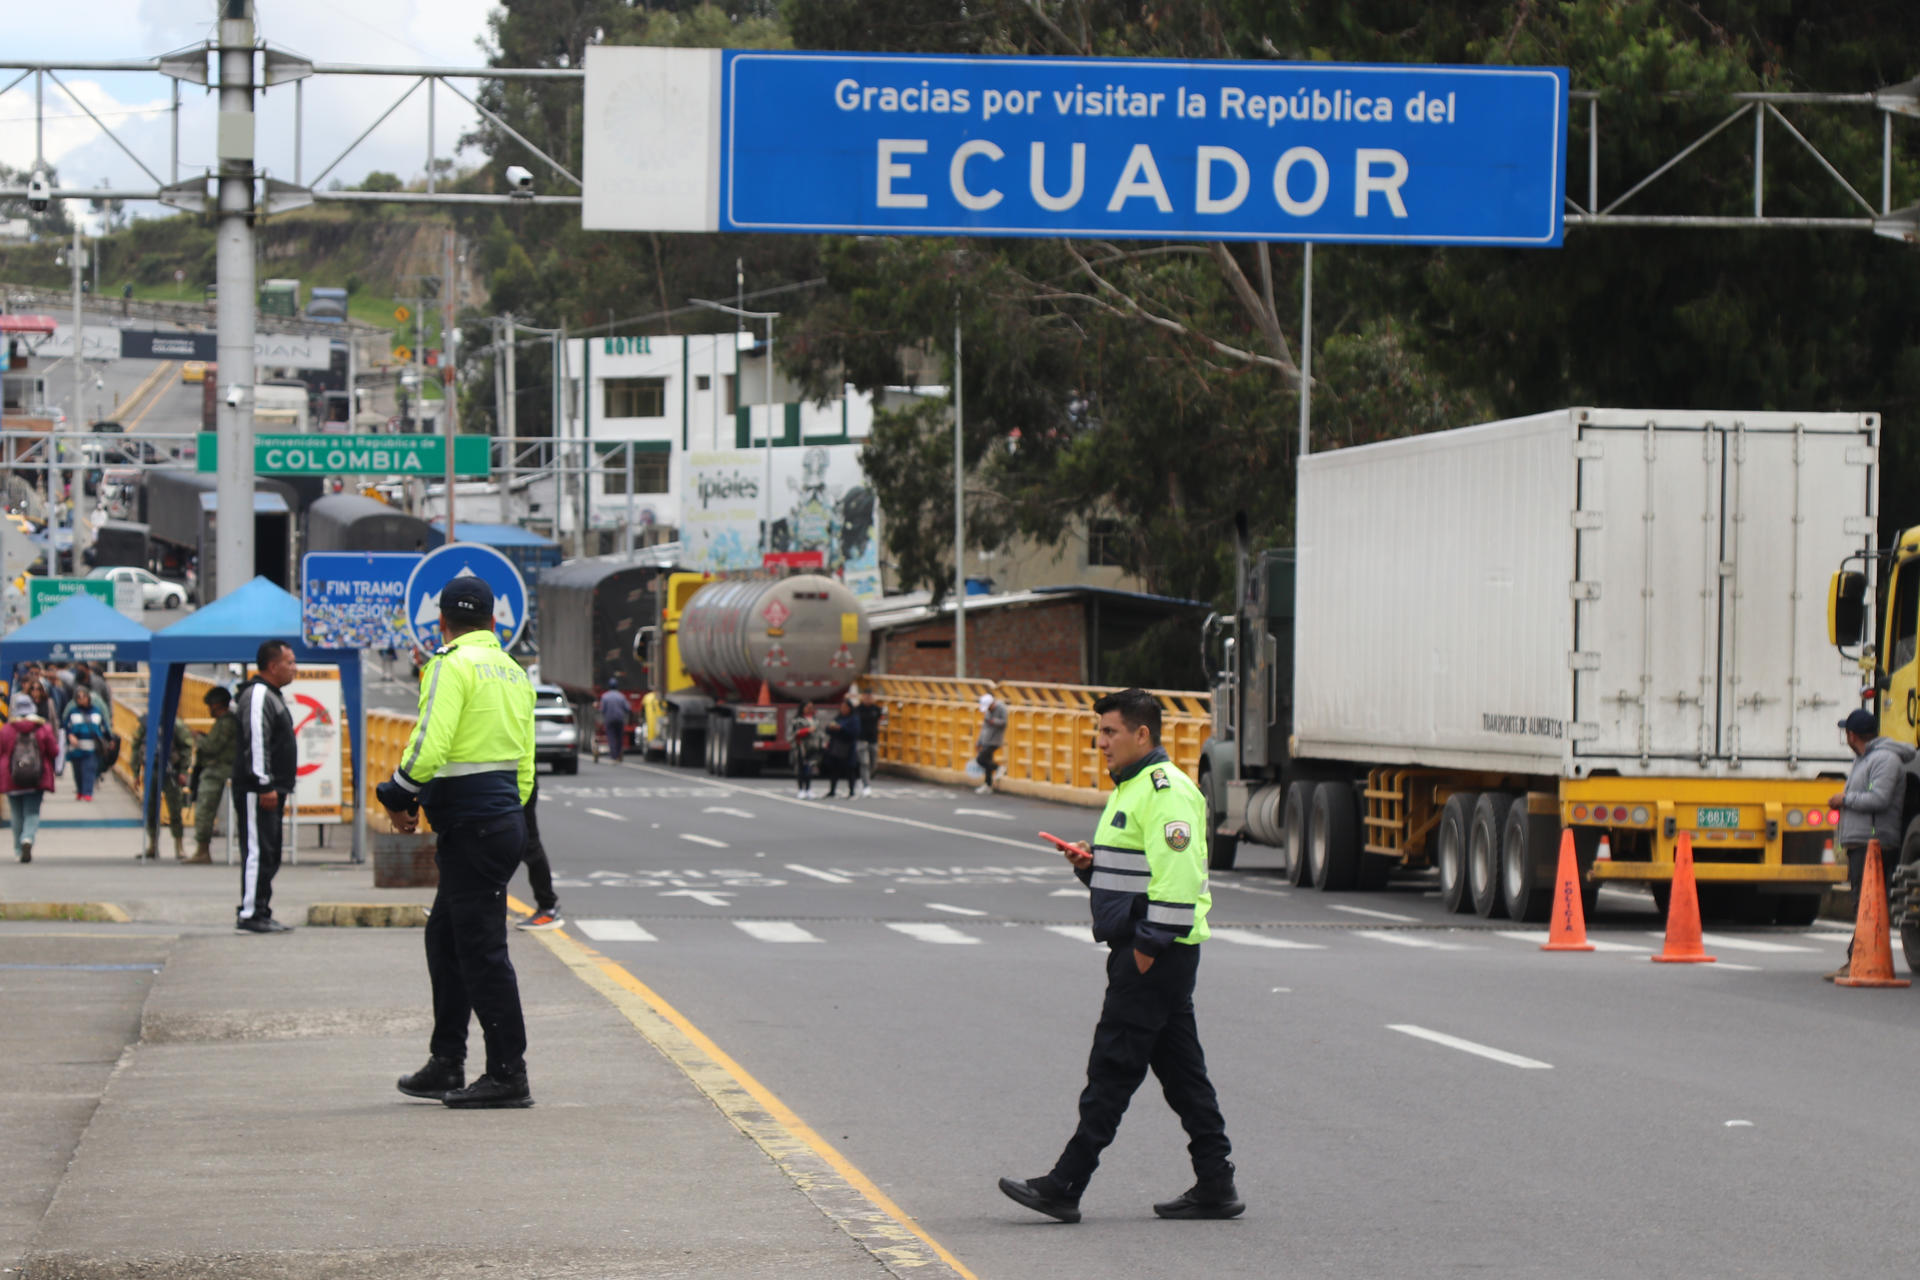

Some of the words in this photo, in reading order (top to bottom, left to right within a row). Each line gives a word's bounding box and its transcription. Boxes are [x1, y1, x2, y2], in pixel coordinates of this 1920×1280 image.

[835, 78, 970, 112] Gracias
[983, 89, 1041, 122] por
[1053, 84, 1165, 117] visitar
[1177, 86, 1206, 118] la
[1220, 86, 1393, 128] República
[1405, 90, 1455, 124] del
[876, 138, 1409, 218] ECUADOR
[604, 336, 652, 355] HOTEL
[254, 437, 327, 448] Bienvenidos
[330, 440, 338, 448] a
[357, 437, 417, 450] República
[420, 438, 436, 448] de
[265, 450, 422, 470] COLOMBIA
[326, 580, 350, 596] FIN
[352, 580, 404, 597] TRAMO
[1482, 713, 1518, 734] TRANSPORTE
[1519, 716, 1527, 735] DE
[1529, 717, 1562, 739] ALIMENTOS
[1563, 880, 1573, 932] POLICIA
